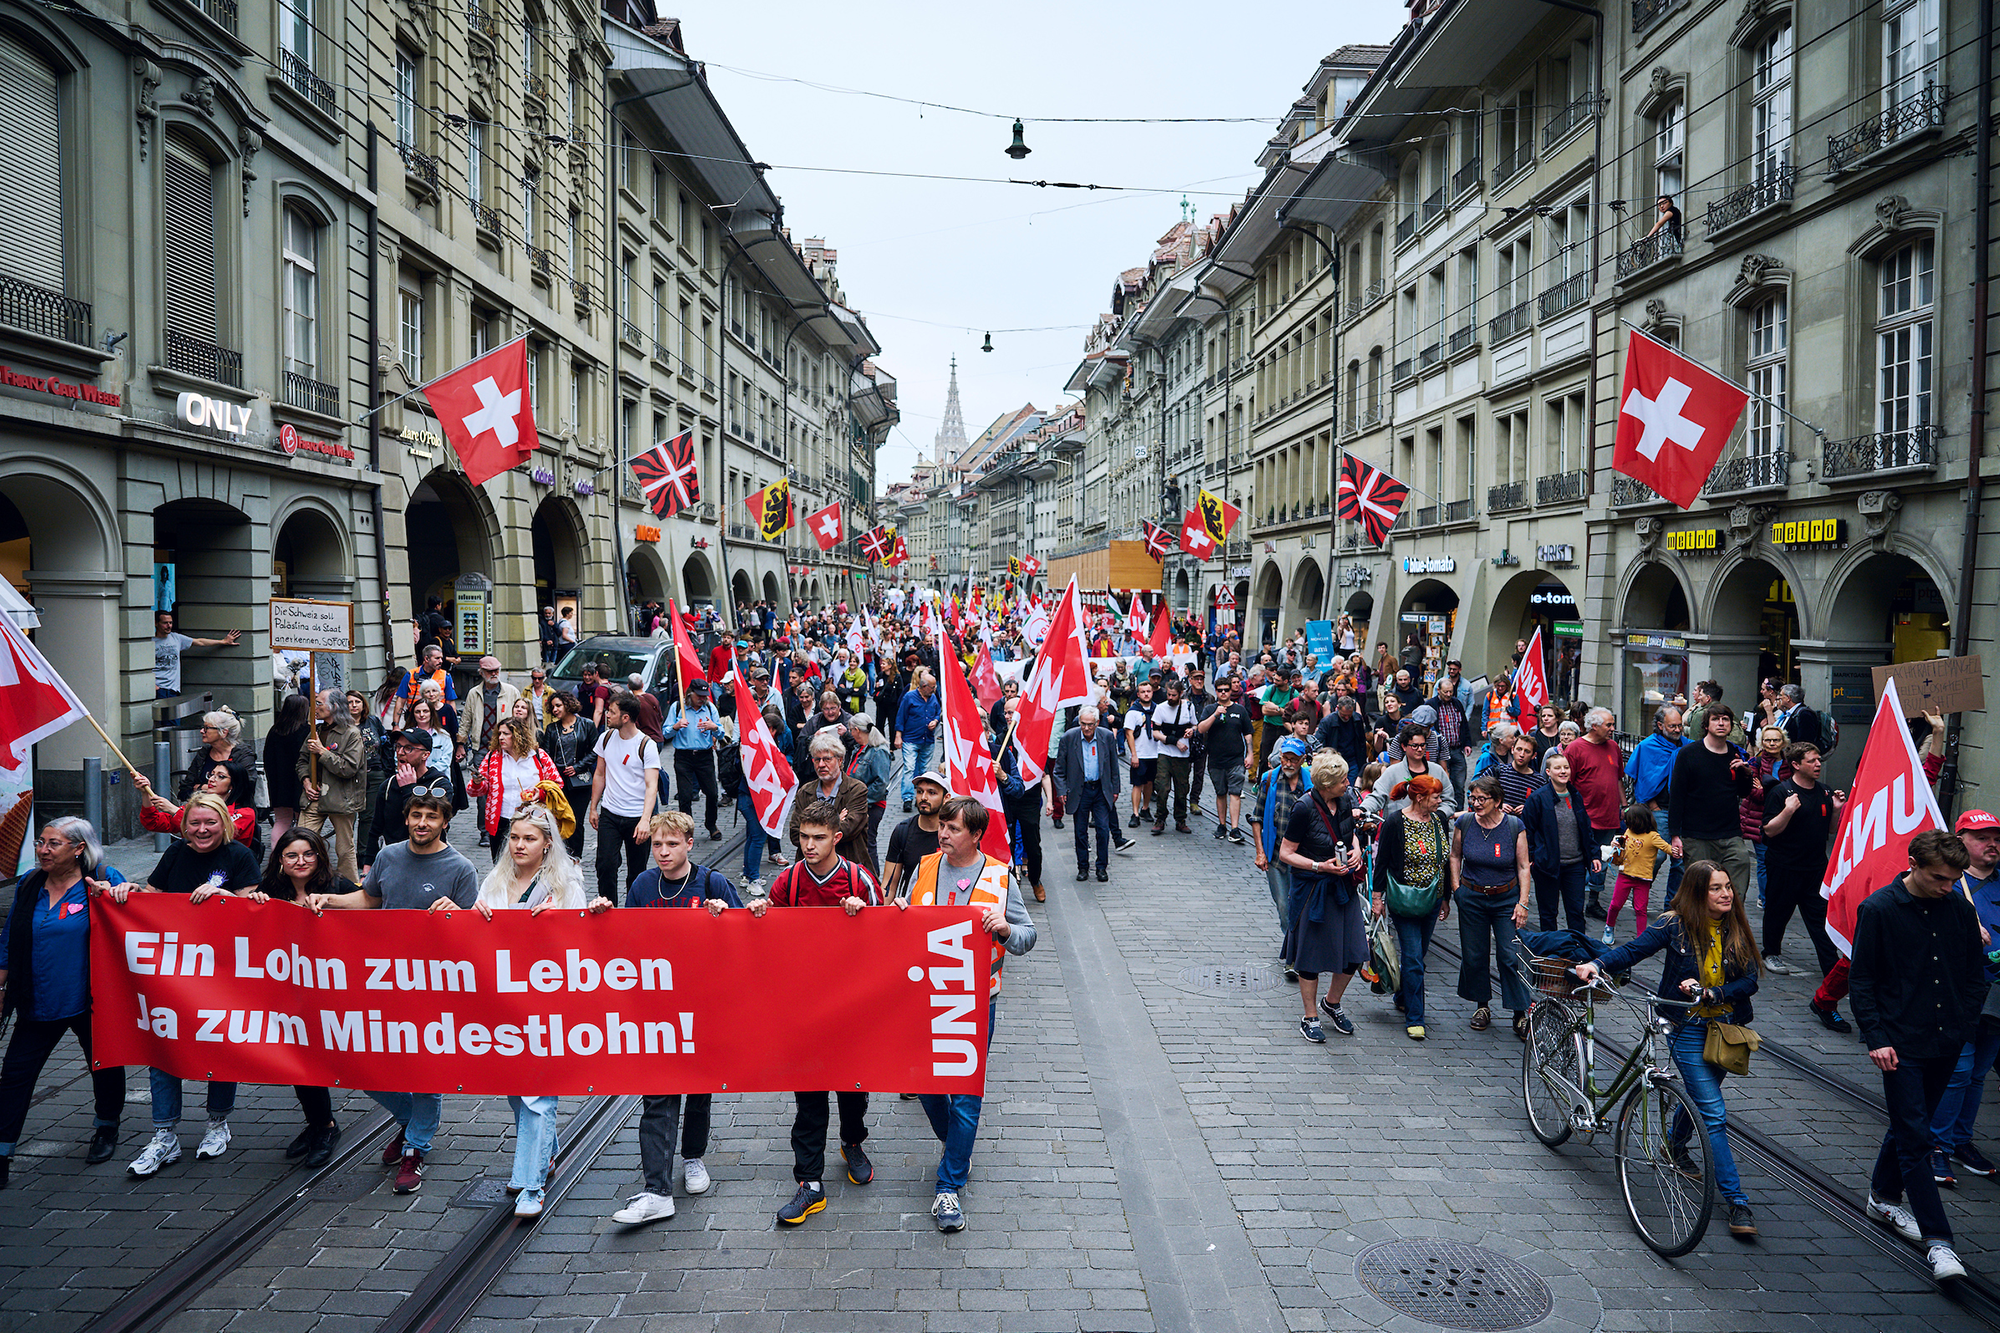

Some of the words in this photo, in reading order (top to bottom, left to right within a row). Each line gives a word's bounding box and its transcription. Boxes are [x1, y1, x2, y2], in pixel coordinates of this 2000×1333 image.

[178, 392, 252, 436] ONLY
[1667, 532, 1714, 548] metro
[1772, 522, 1835, 542] metro
[1537, 544, 1574, 562] CHRIST
[124, 931, 215, 977] Ein
[234, 936, 348, 990] Lohn
[364, 957, 477, 992] zum
[495, 948, 674, 993] Leben
[136, 992, 179, 1040] Ja
[195, 1009, 310, 1047] zum
[319, 1009, 696, 1057] Mindestlohn!
